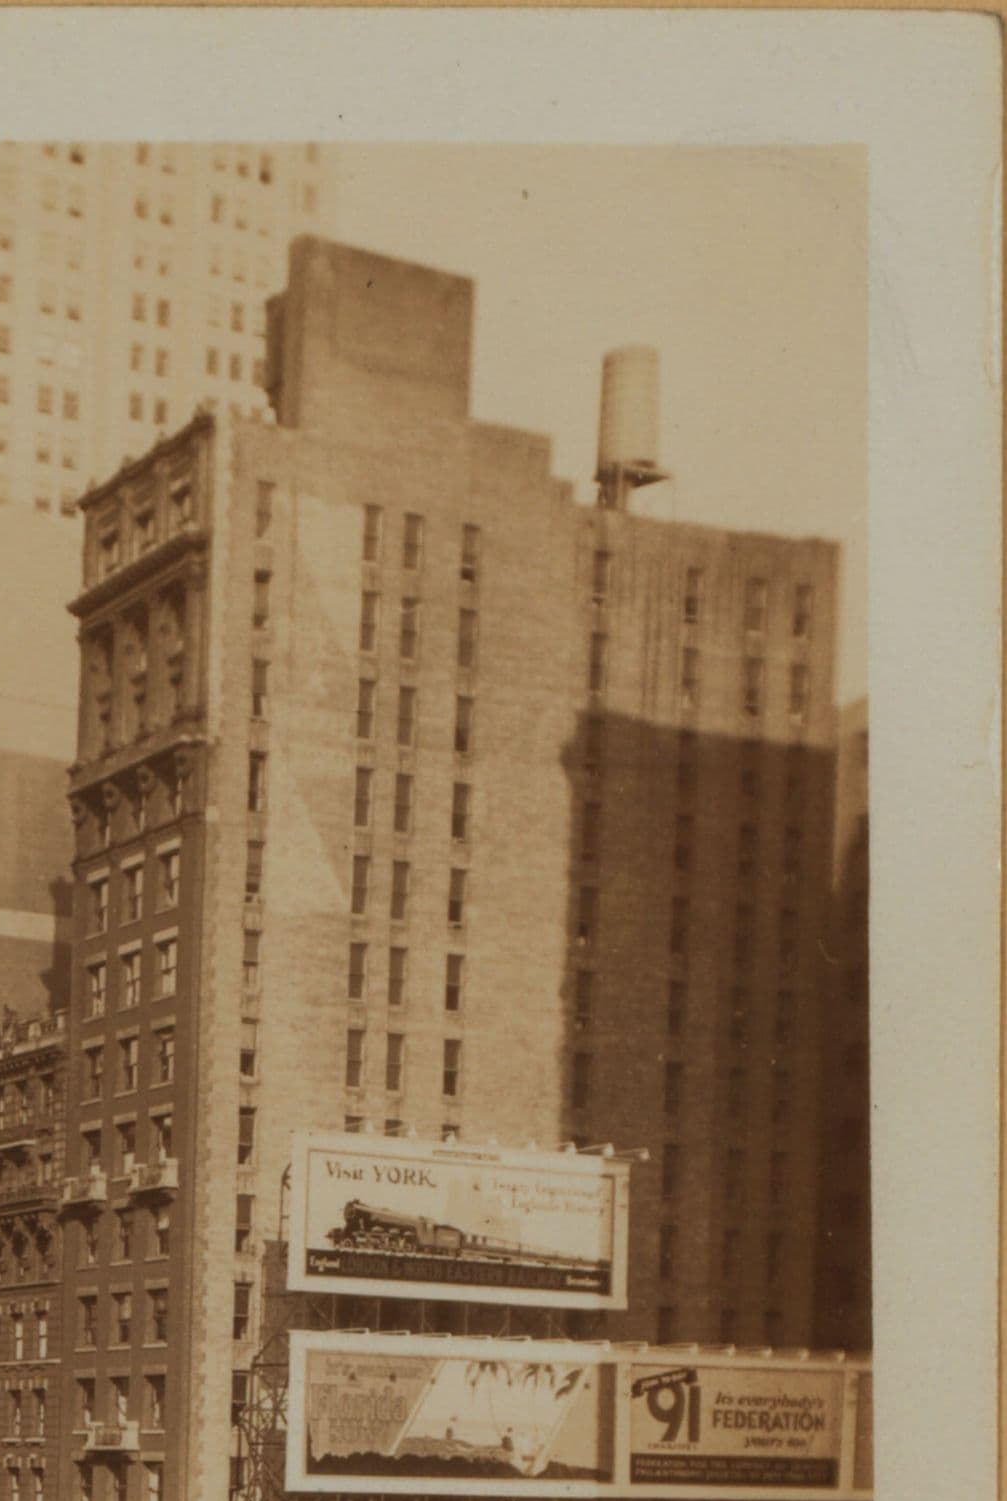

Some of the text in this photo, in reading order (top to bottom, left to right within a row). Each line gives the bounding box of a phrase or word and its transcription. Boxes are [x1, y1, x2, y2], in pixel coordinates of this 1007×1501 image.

[326, 1160, 437, 1189] Visit YORK
[647, 1381, 701, 1443] 91
[712, 1409, 826, 1434] FEDERATION
